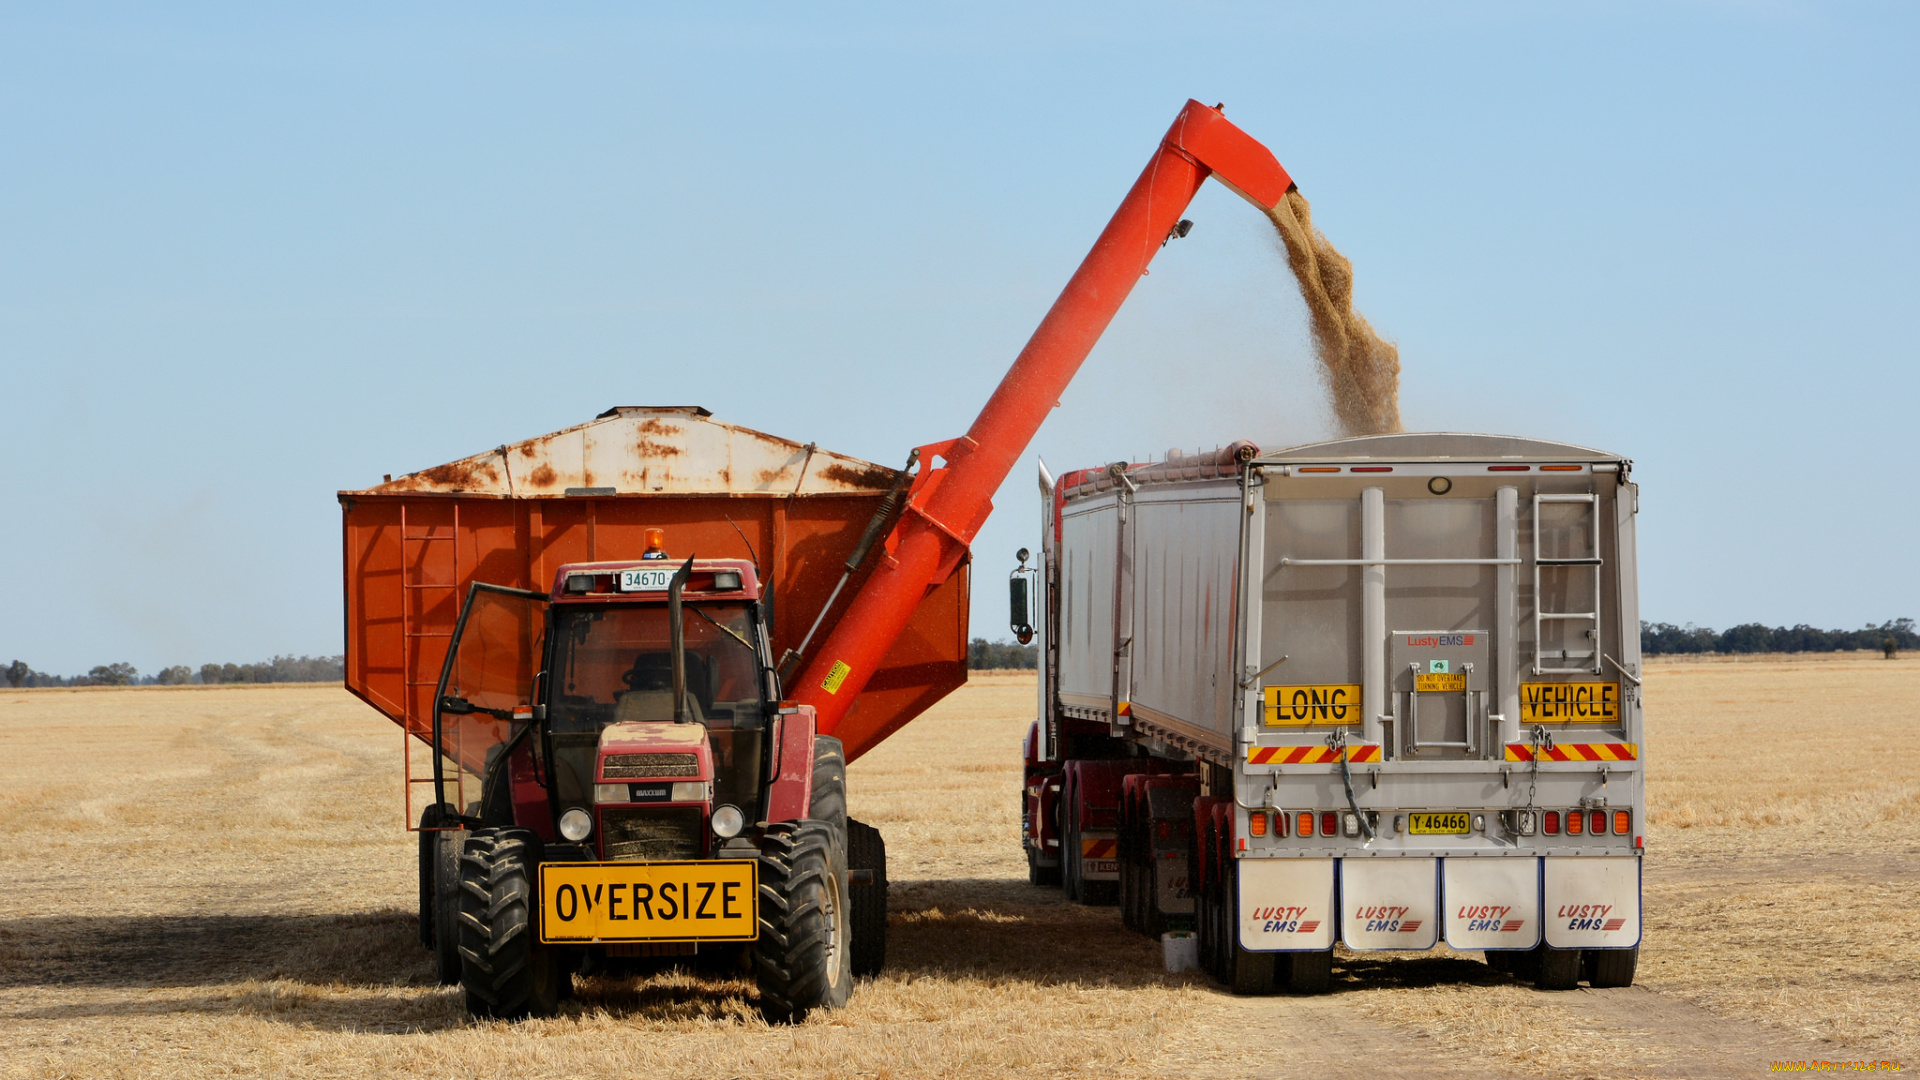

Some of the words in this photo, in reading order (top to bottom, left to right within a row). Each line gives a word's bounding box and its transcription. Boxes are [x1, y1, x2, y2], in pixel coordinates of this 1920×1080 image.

[1437, 674, 1463, 682] OVERTAKE
[1418, 682, 1439, 690] TURNING
[1277, 689, 1347, 720] LONG
[1527, 686, 1613, 717] VEHICLE
[635, 789, 666, 797] MAXXUM
[555, 881, 742, 922] OVERSIZE
[1253, 906, 1308, 920] LUSTY
[1355, 906, 1409, 919] LUSTY
[1458, 906, 1511, 919] LUSTY
[1558, 904, 1613, 918] LUSTY
[1263, 920, 1297, 933] EMS
[1365, 920, 1399, 932] EMS
[1468, 919, 1500, 932] EMS
[1569, 918, 1602, 931] EMS
